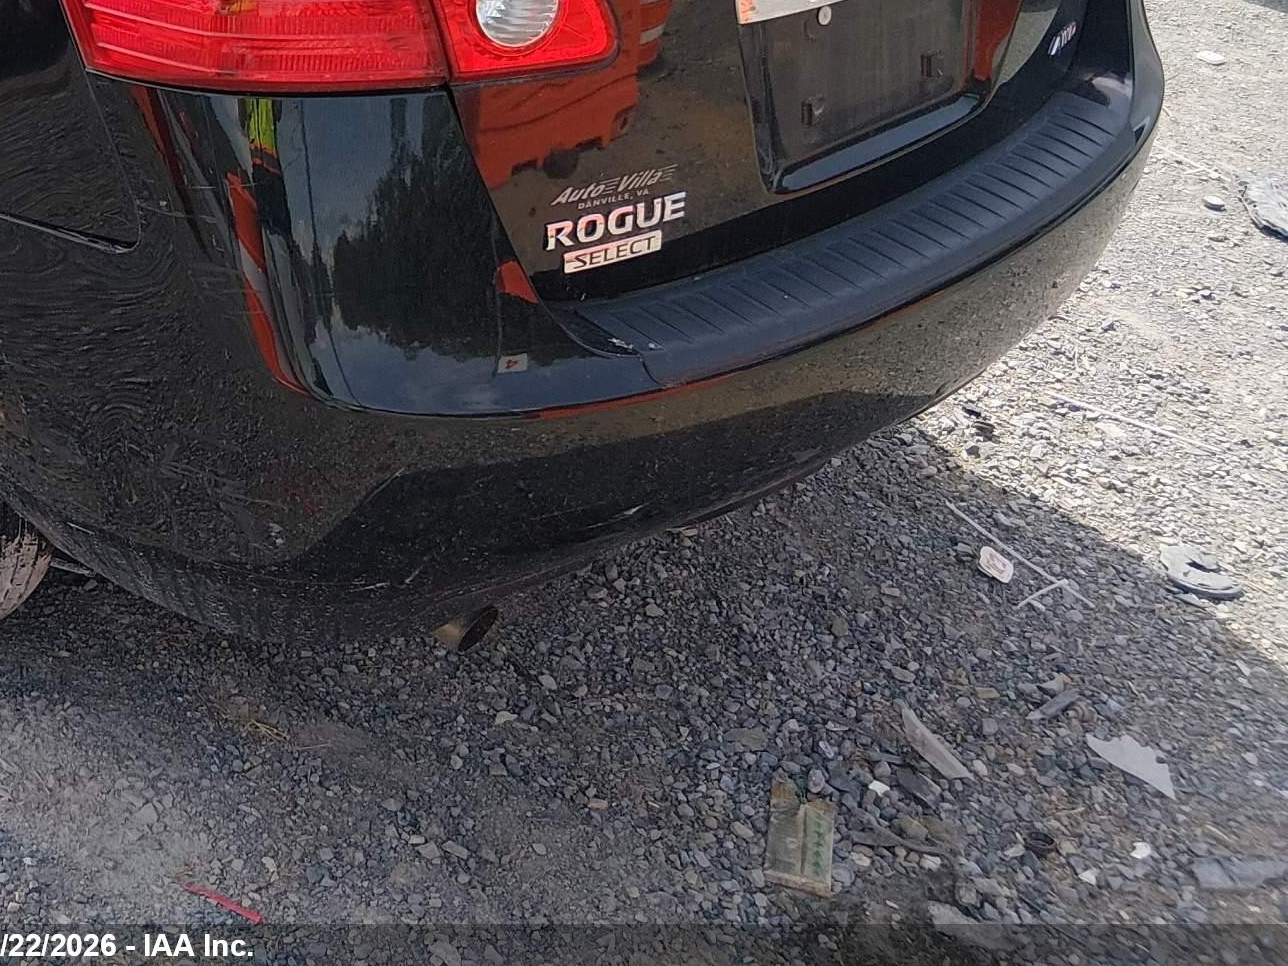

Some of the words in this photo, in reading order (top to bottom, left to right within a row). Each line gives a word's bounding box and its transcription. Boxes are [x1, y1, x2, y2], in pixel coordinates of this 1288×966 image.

[551, 183, 605, 206] Auto
[617, 169, 664, 193] Villa
[544, 191, 687, 251] ROGUE
[573, 235, 656, 270] SELECT
